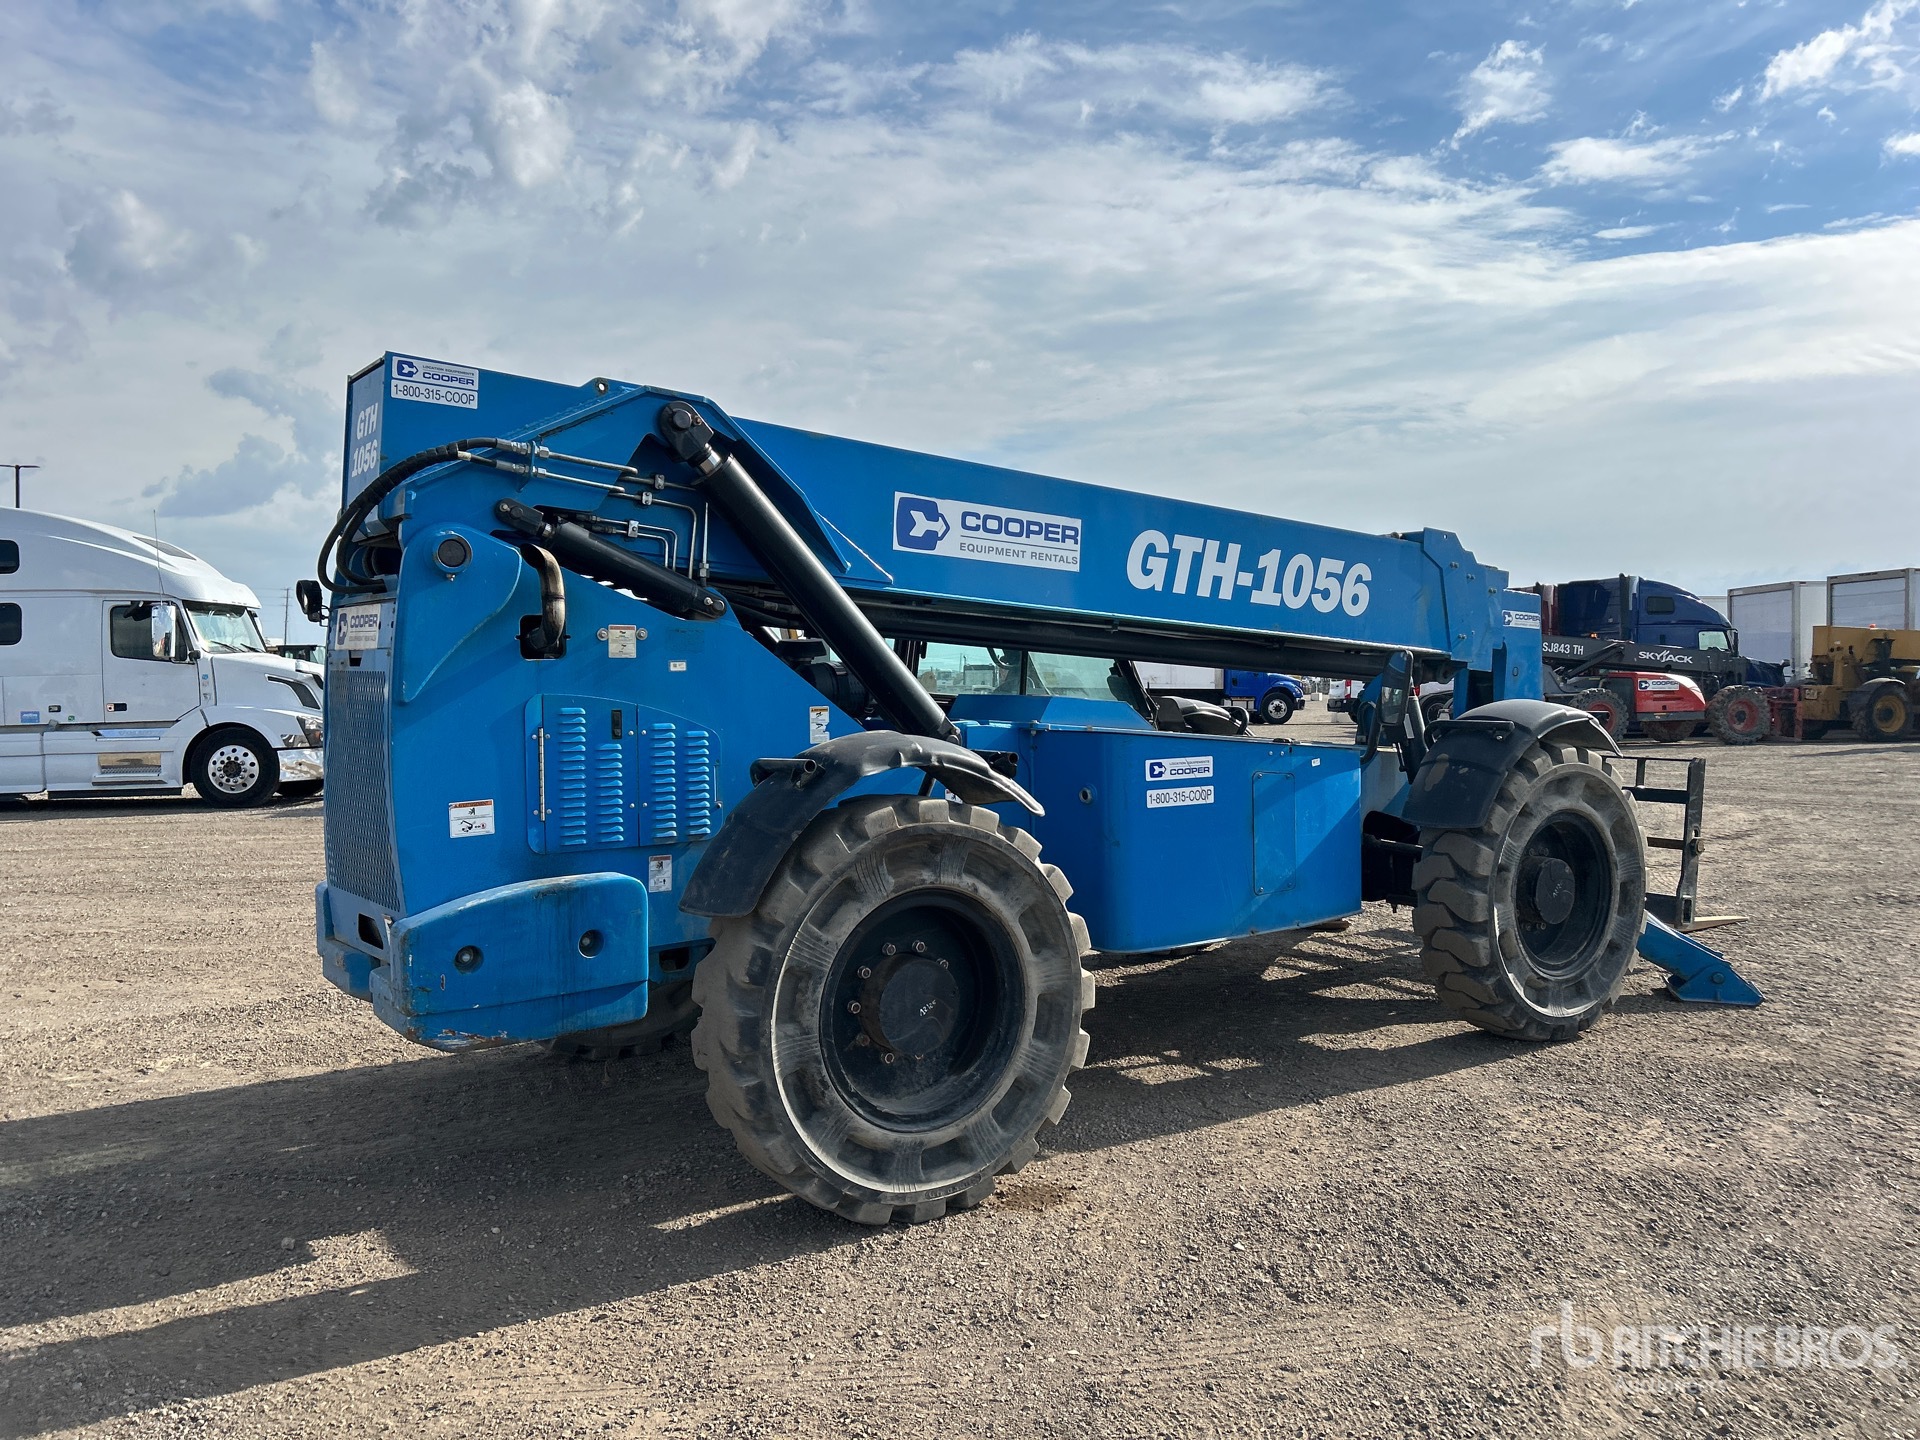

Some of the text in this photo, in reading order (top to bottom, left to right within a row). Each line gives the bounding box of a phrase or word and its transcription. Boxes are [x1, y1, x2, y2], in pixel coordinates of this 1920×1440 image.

[422, 371, 475, 387] COOPER
[393, 383, 476, 406] 1-800-315-COOP
[356, 402, 379, 440] GTH
[351, 439, 378, 478] 1056
[960, 511, 1080, 545] COOPER
[959, 542, 1078, 565] EQUIPMENT RENTALS
[1126, 529, 1373, 617] GTH-1056
[350, 613, 378, 629] COOPER
[1542, 642, 1584, 656] SJ843 TH
[1638, 649, 1693, 664] SKYJACK
[1169, 766, 1210, 776] COOPER
[1148, 789, 1212, 805] 1-800-315-COOP
